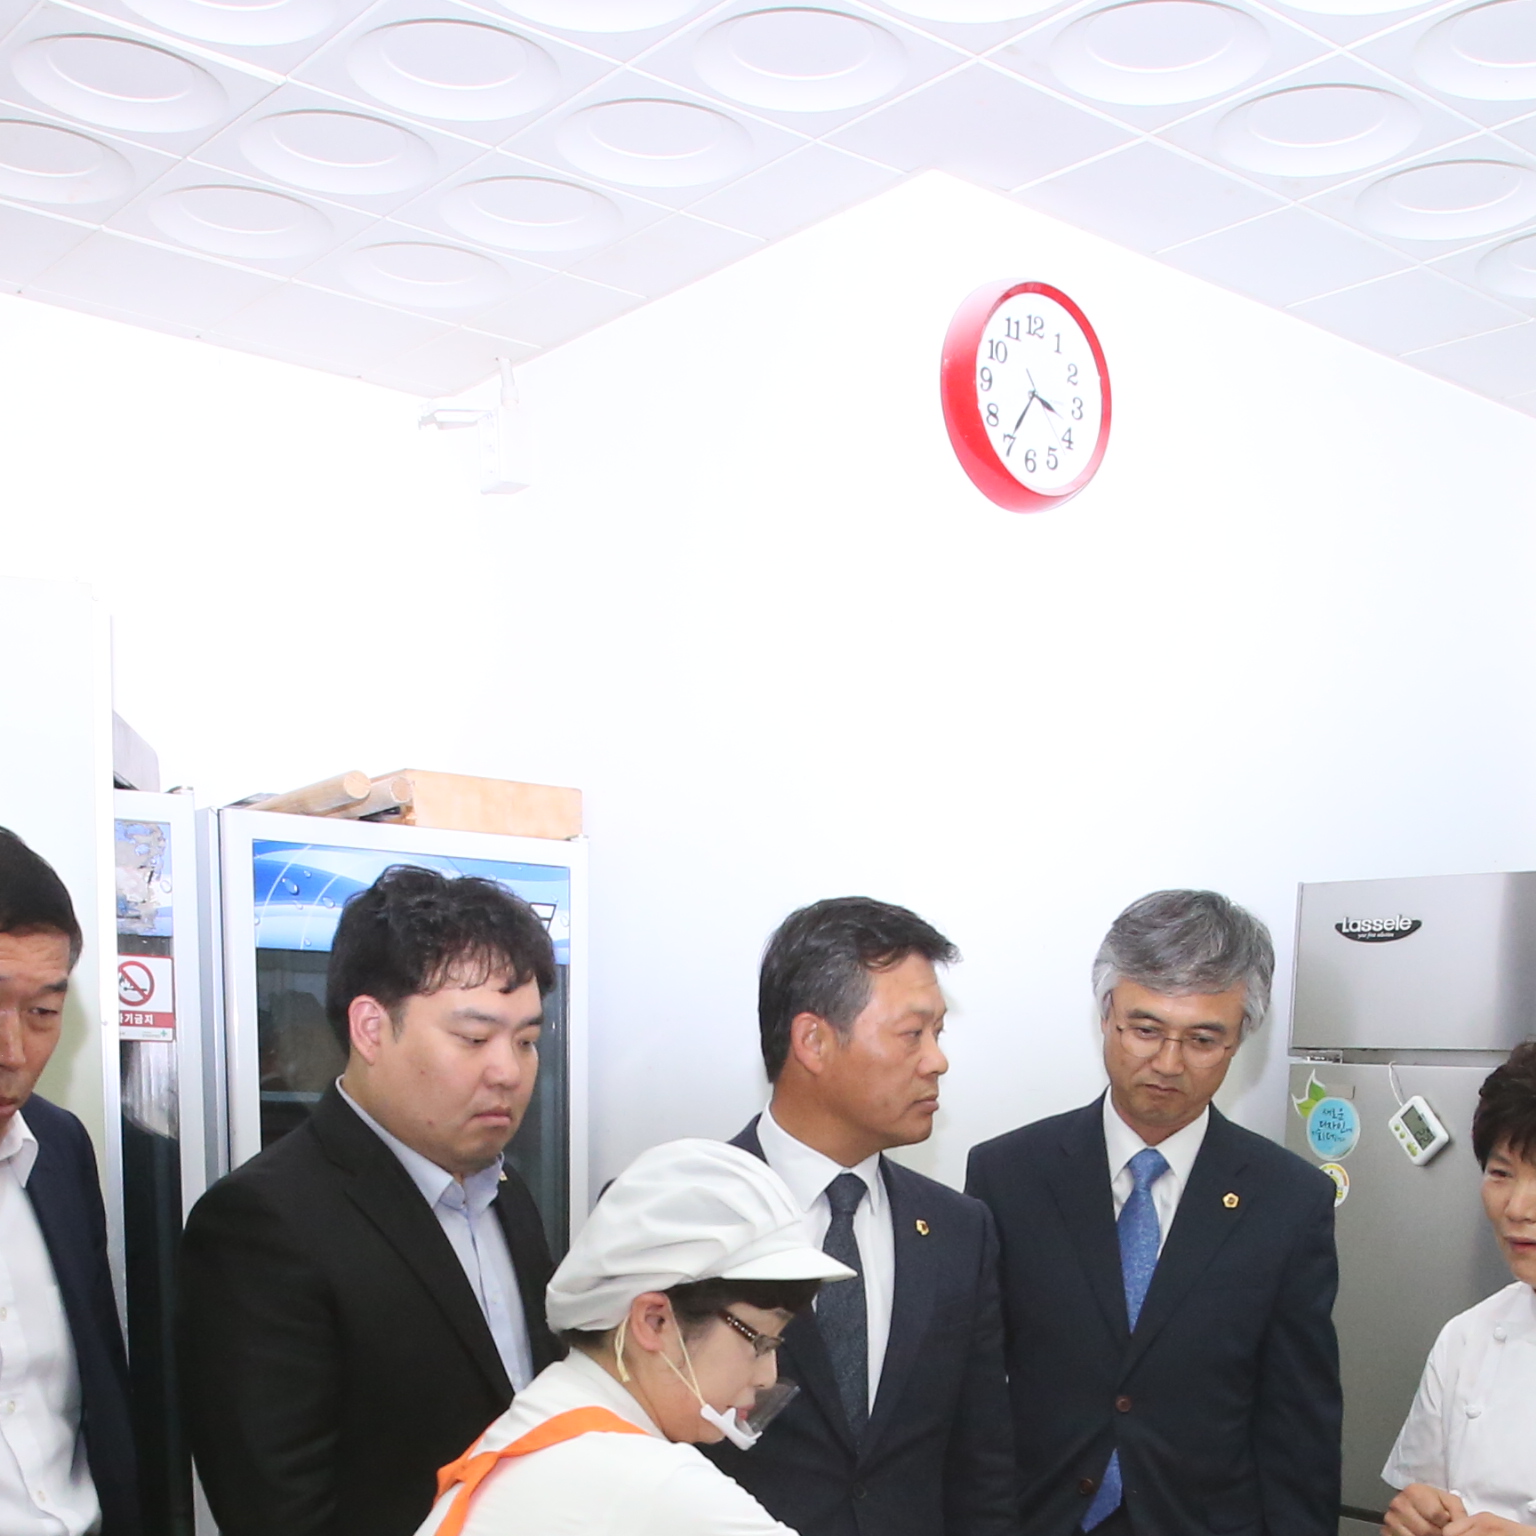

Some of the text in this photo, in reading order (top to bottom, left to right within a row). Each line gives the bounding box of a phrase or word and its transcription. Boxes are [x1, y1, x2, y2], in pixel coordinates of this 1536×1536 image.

[1005, 317, 1021, 341] 11
[1025, 315, 1044, 339] 12
[988, 339, 1008, 363] 10
[1054, 333, 1062, 354] 1
[980, 366, 993, 391] 9
[1067, 363, 1078, 385] 2
[986, 403, 999, 427] 8
[1071, 397, 1083, 420] 3
[1003, 433, 1016, 457] 7
[1061, 427, 1074, 450] 4
[1024, 449, 1037, 473] 6
[1046, 446, 1058, 470] 5
[1342, 914, 1412, 933] Lassele
